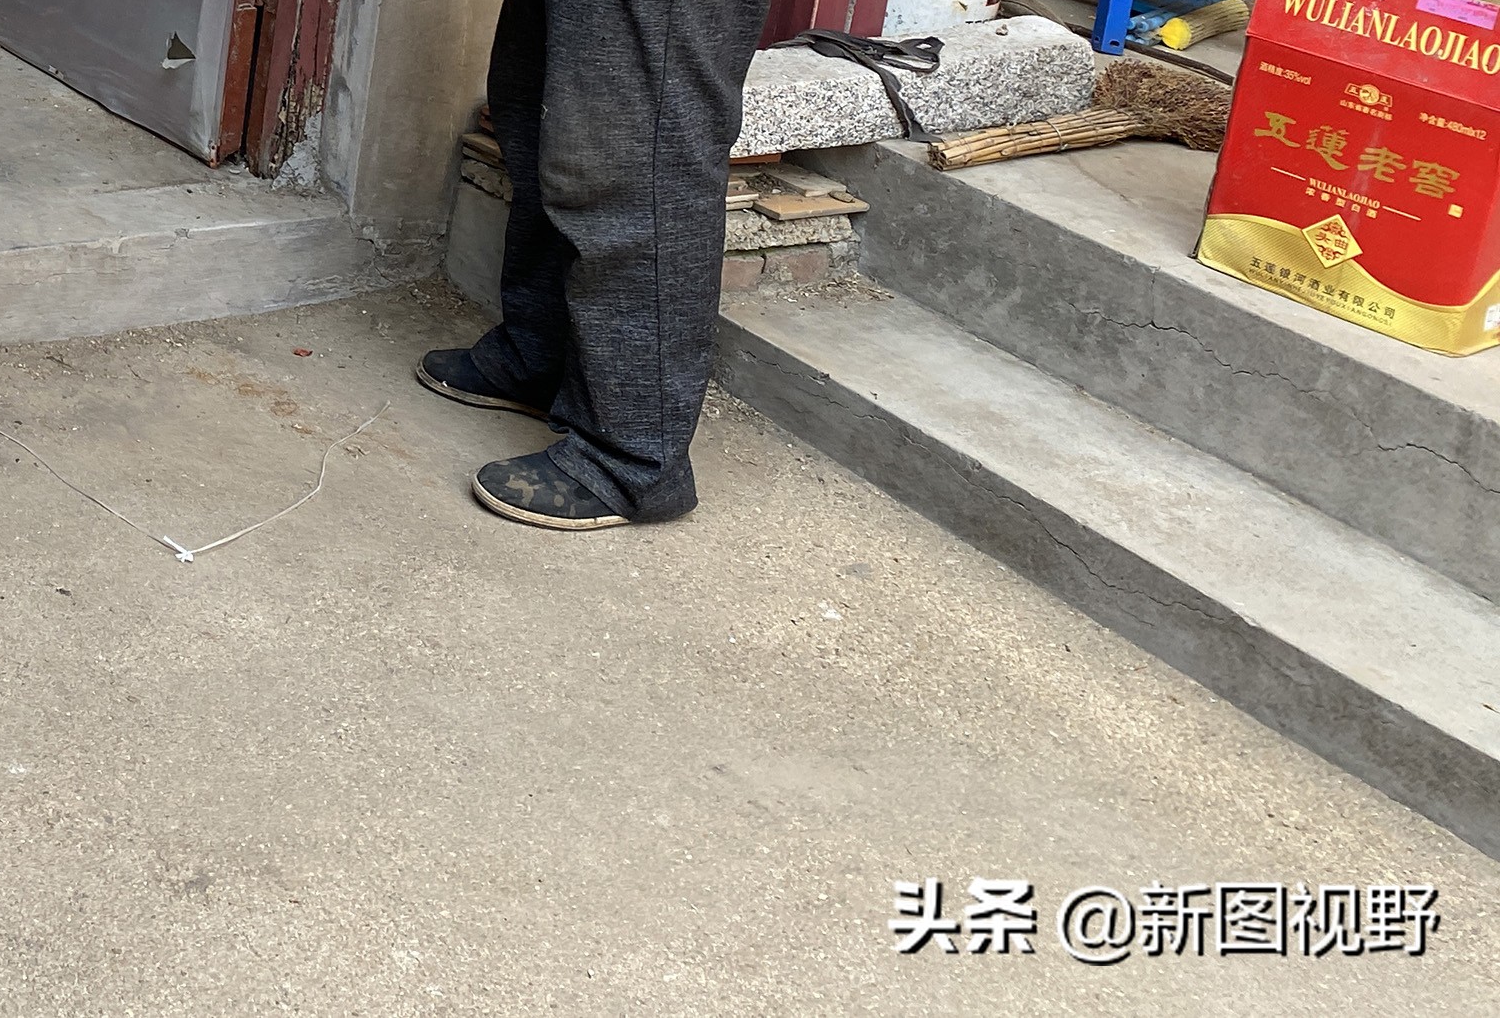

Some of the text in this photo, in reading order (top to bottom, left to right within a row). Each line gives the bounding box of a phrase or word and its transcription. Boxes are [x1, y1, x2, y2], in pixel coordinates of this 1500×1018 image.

[1305, 187, 1378, 219] 浓香型白酒
[1315, 231, 1348, 250] 头曲
